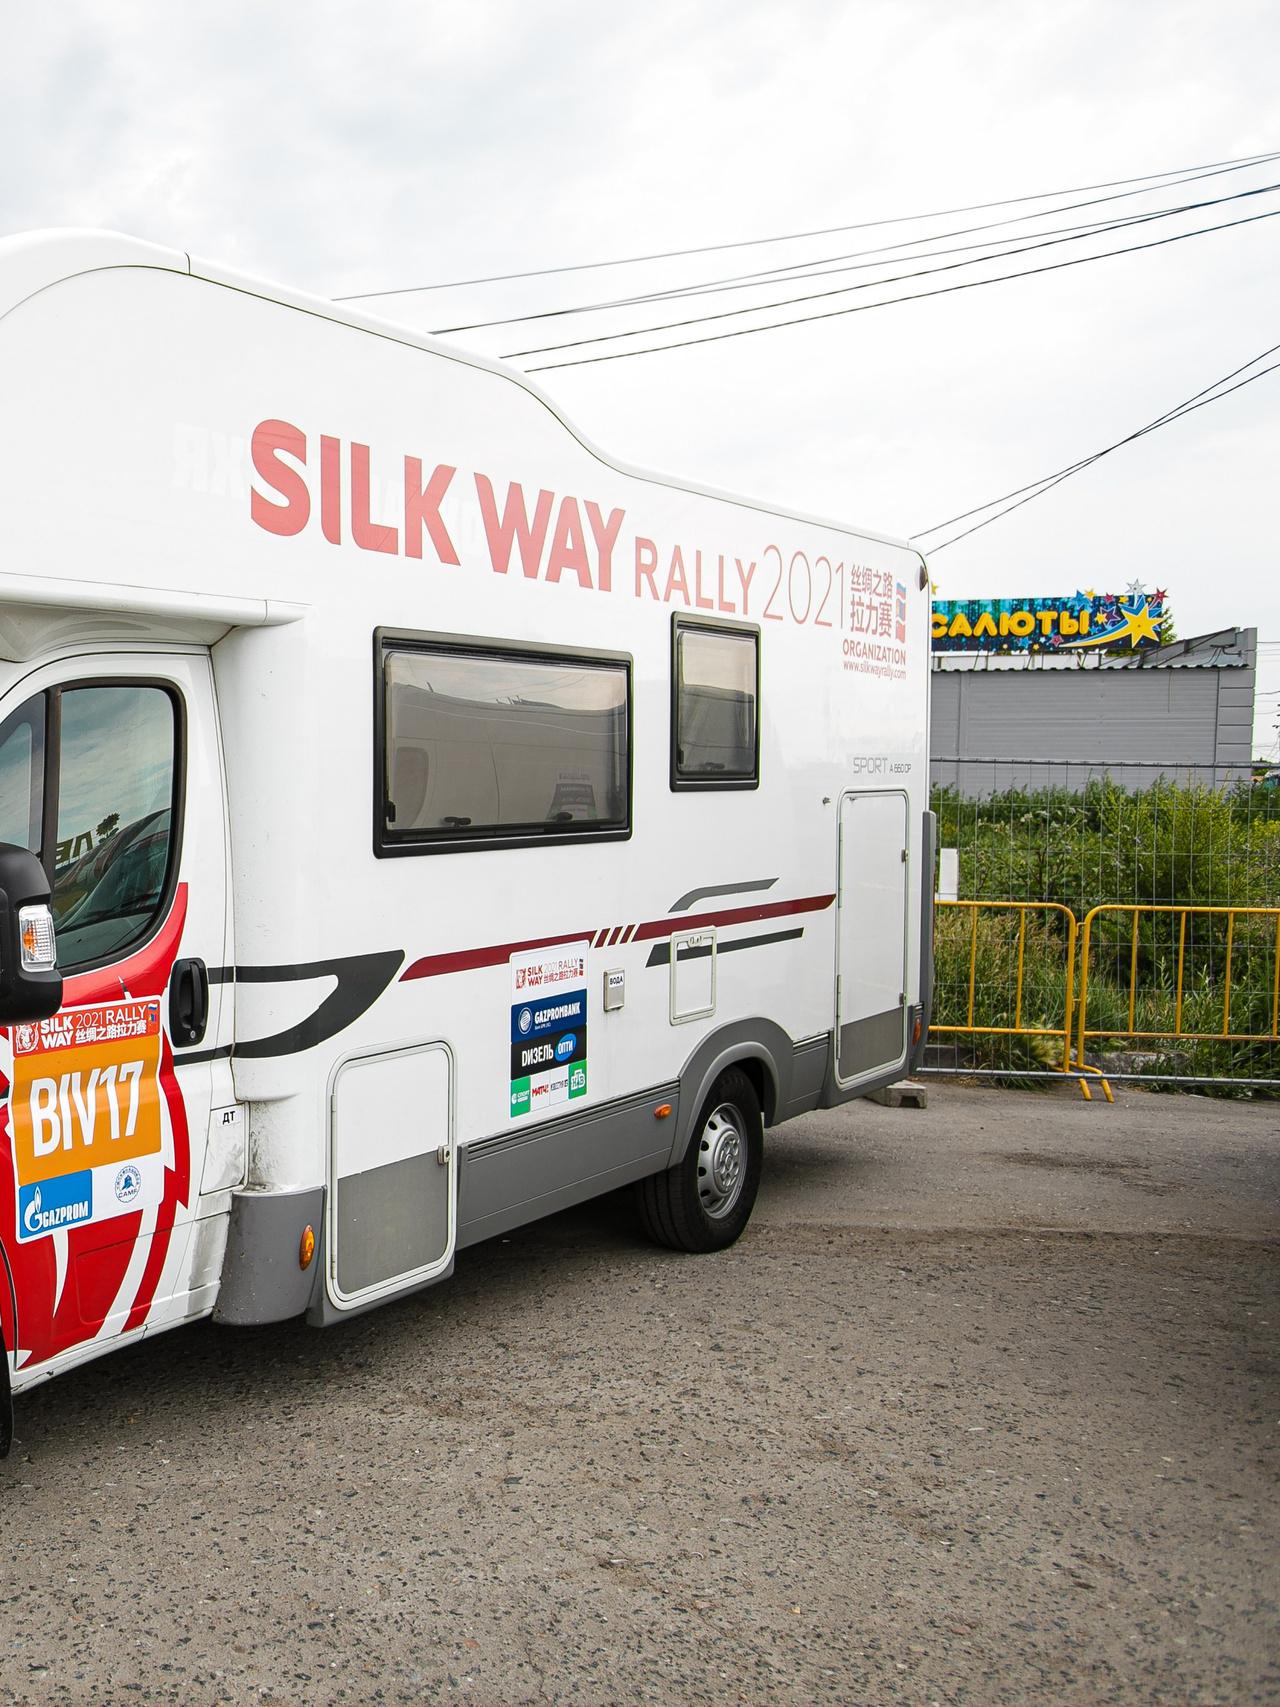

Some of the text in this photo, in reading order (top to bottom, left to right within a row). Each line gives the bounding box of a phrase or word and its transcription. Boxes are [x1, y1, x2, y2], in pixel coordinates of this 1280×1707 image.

[251, 419, 460, 566] SILK
[473, 471, 625, 593] WAY
[635, 536, 757, 615] RALLY
[762, 543, 844, 629] 2021
[851, 564, 892, 600] 丝绸之路
[851, 594, 892, 638] 拉力赛
[931, 610, 1090, 638] САЛЮТЫ
[843, 639, 906, 666] ORGANIZATION
[843, 660, 906, 680] www.silkwayrally.com
[853, 757, 888, 774] SPORT
[527, 965, 543, 977] SILK
[558, 958, 579, 969] RALLY
[527, 975, 543, 987] WAY
[609, 976, 623, 985] ВОДА
[40, 1004, 147, 1035] SILK 2021 RALLY
[534, 1001, 581, 1024] GAZPROMBANK
[41, 1031, 75, 1049] WAY
[75, 1019, 147, 1044] 丝绸之路拉力赛
[30, 1060, 145, 1158] BIV17
[222, 1110, 235, 1125] ДТ
[42, 1200, 89, 1228] GAZPROM
